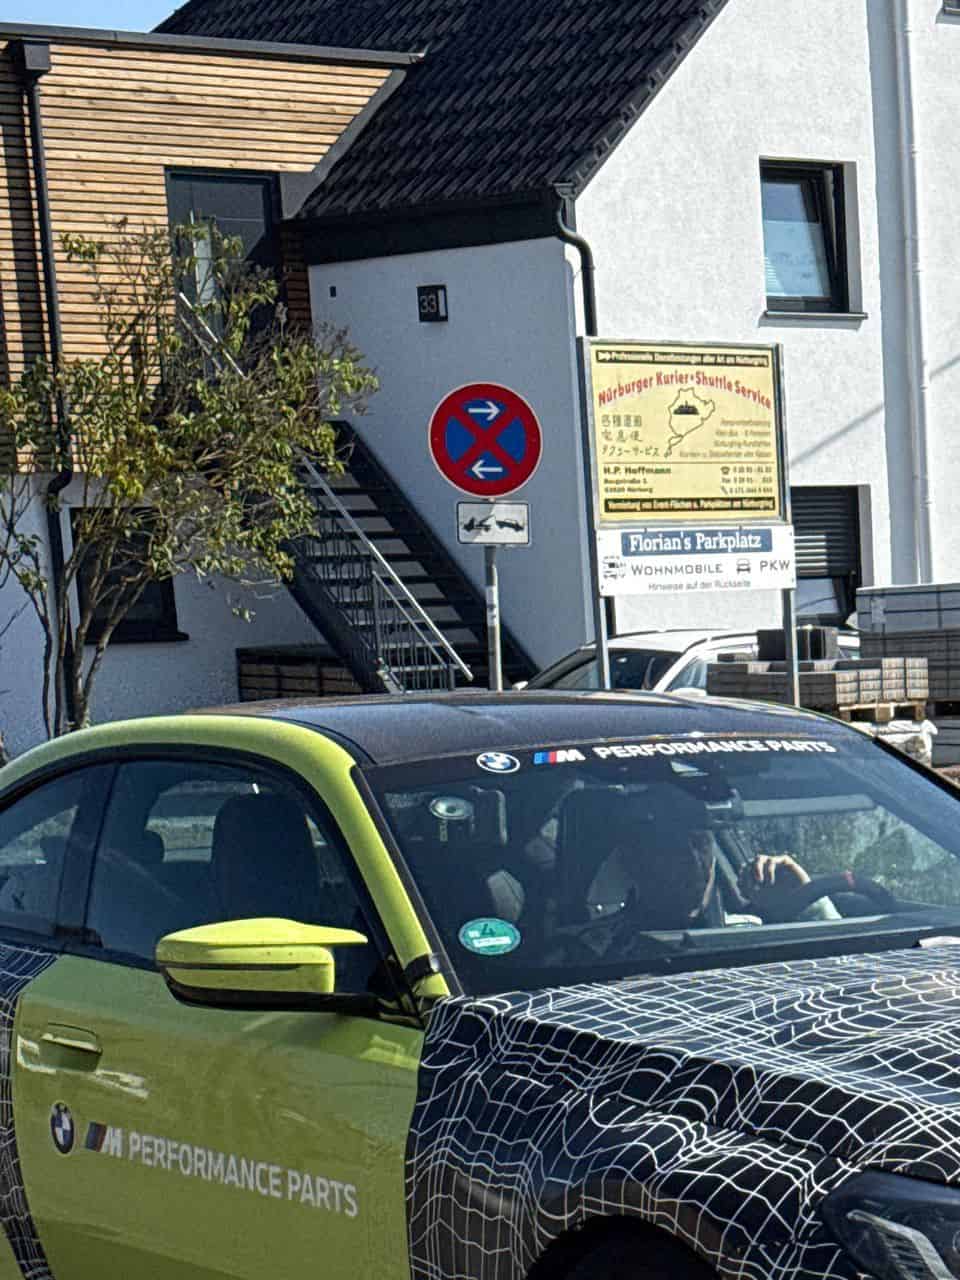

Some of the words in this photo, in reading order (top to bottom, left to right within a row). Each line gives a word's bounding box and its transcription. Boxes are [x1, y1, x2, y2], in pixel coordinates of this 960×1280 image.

[598, 376, 654, 408] Nürburger
[735, 380, 772, 409] Service
[630, 531, 691, 552] Florian's
[695, 531, 762, 553] Parkplatz
[631, 563, 723, 576] WOHNMOBILE
[760, 560, 790, 571] PKW
[592, 740, 760, 759] PERFORMANCE
[757, 740, 837, 753] PARTS
[129, 1131, 282, 1198] PERFORMANCE
[287, 1169, 358, 1218] PARTS
